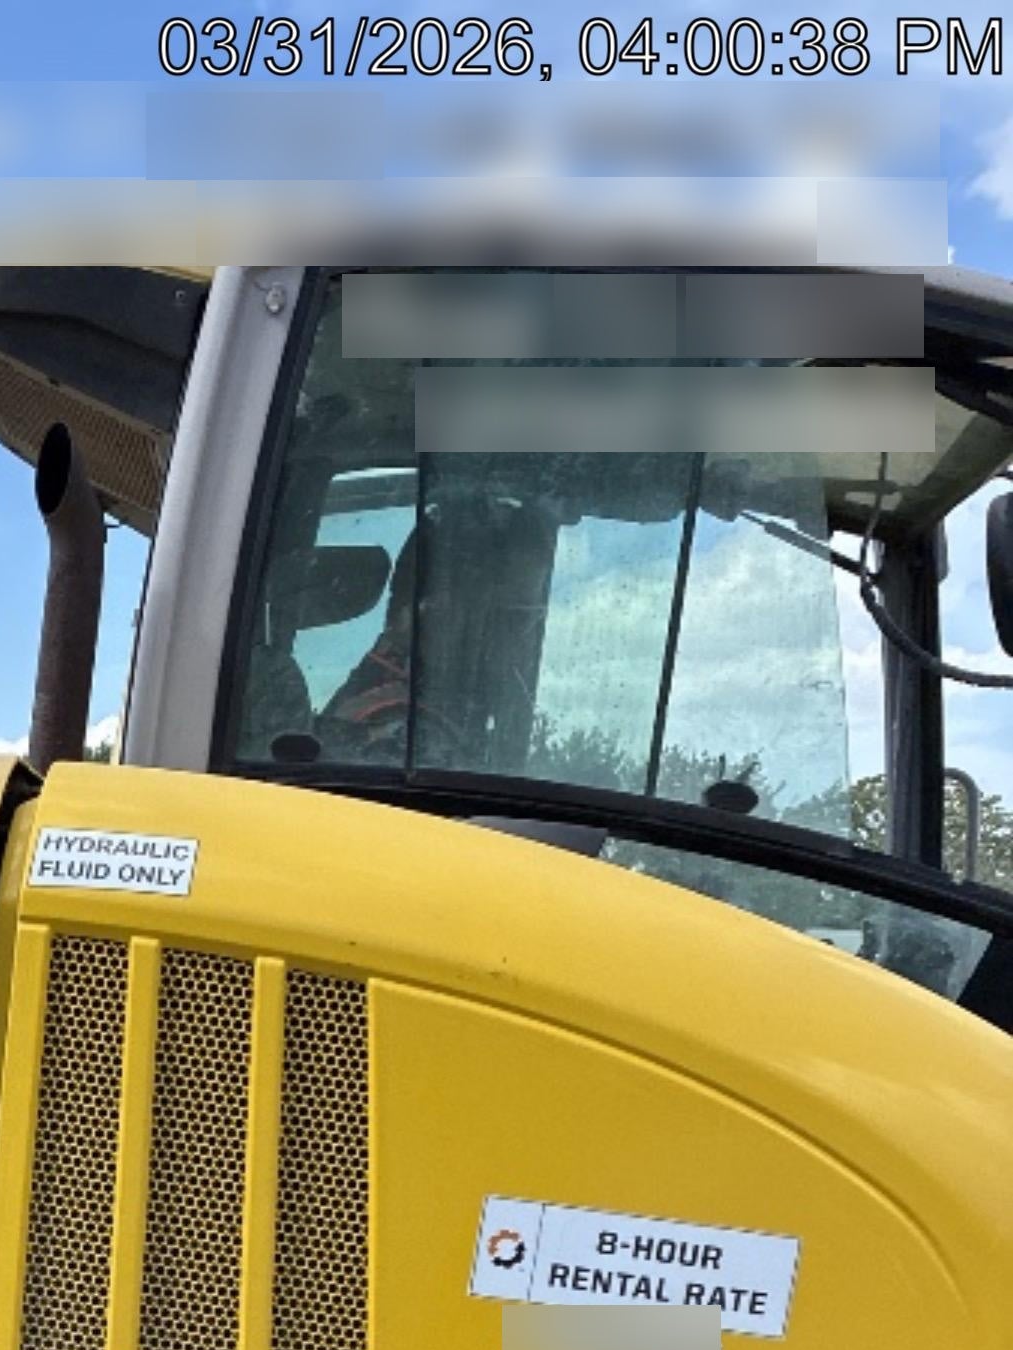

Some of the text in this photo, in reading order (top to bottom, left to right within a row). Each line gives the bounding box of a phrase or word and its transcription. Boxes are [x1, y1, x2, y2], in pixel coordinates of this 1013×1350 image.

[43, 835, 189, 861] HYDRAULIC
[38, 860, 185, 886] FLUID ONLY
[597, 1230, 723, 1269] 8-HOUR
[548, 1262, 768, 1316] RENTAL RATE
